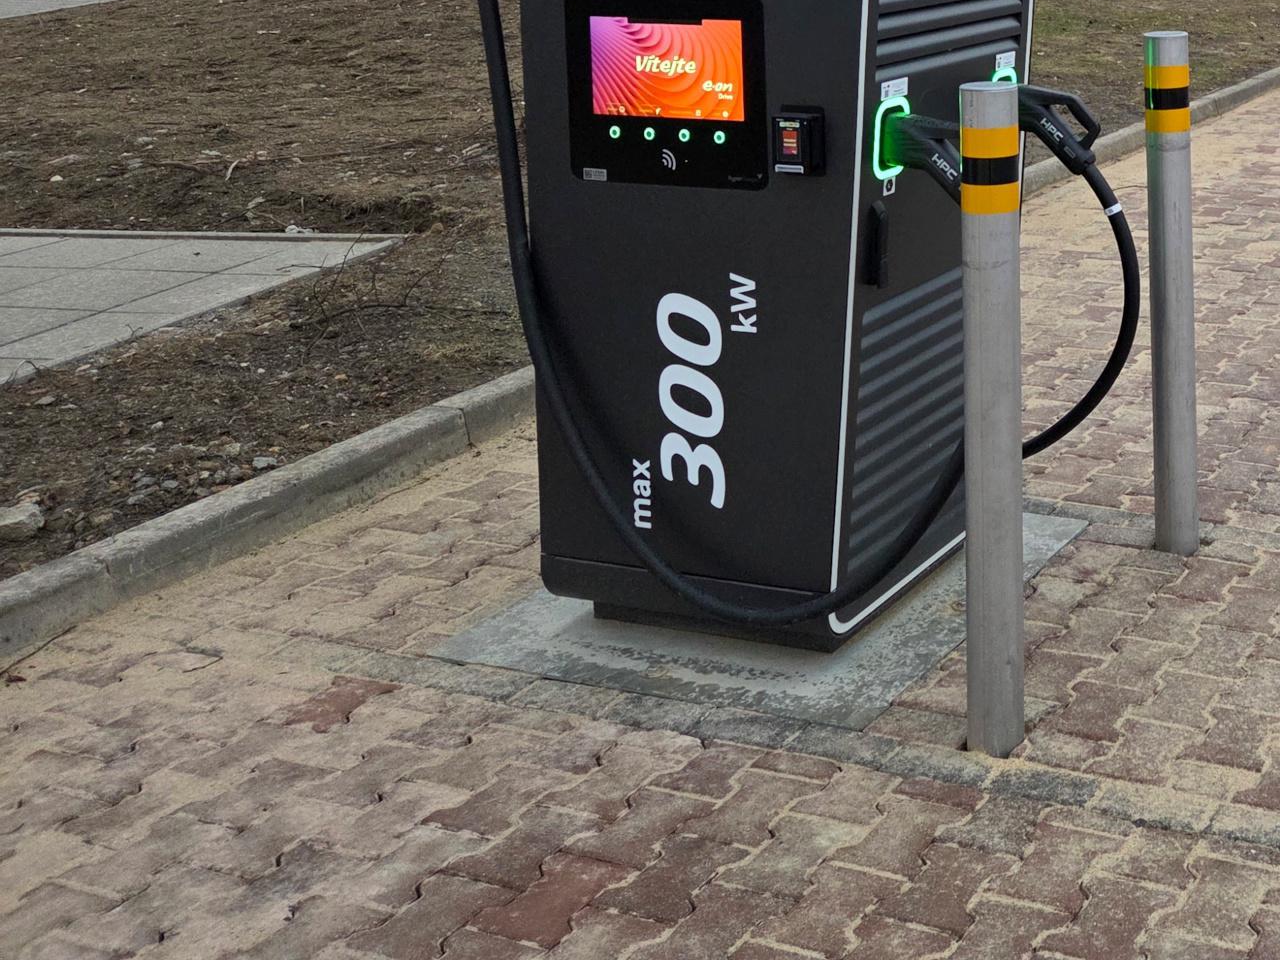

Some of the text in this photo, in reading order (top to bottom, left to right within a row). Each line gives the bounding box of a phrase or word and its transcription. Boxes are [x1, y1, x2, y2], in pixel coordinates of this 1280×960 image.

[635, 54, 697, 76] Vítejte
[1040, 116, 1064, 142] HPC
[931, 152, 959, 181] HPC
[729, 272, 758, 334] kW
[656, 292, 726, 510] 300
[632, 458, 652, 529] max
